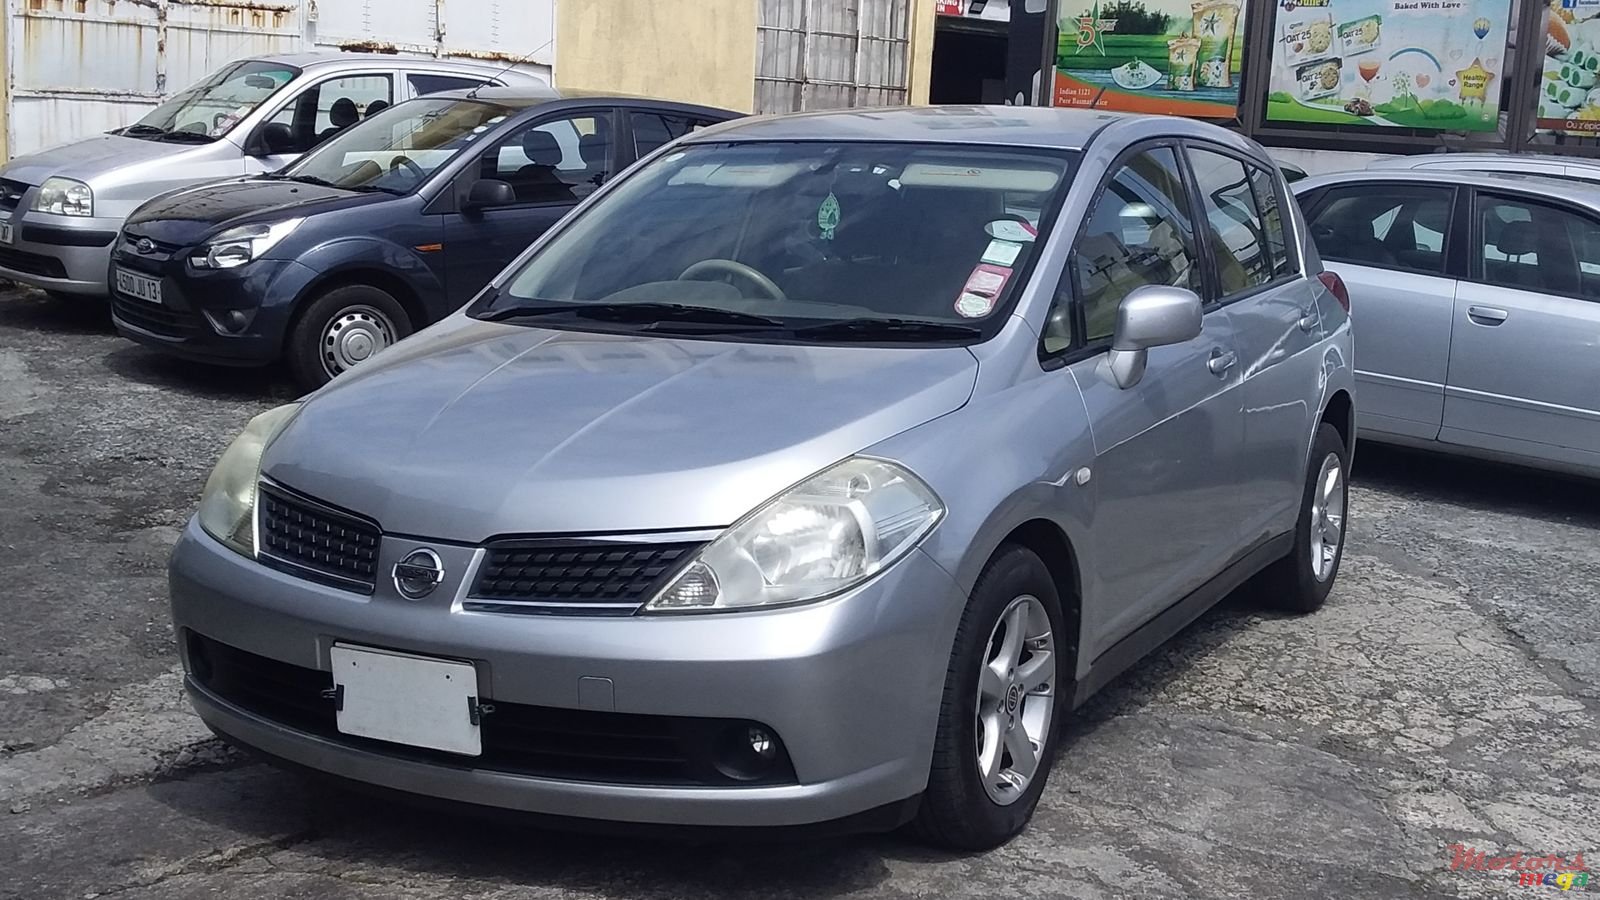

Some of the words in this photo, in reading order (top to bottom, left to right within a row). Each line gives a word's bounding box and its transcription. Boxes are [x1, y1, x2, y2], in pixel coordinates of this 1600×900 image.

[1077, 17, 1095, 46] 5
[1463, 75, 1487, 83] Healthy
[1059, 87, 1077, 95] Indian
[147, 281, 157, 300] 13
